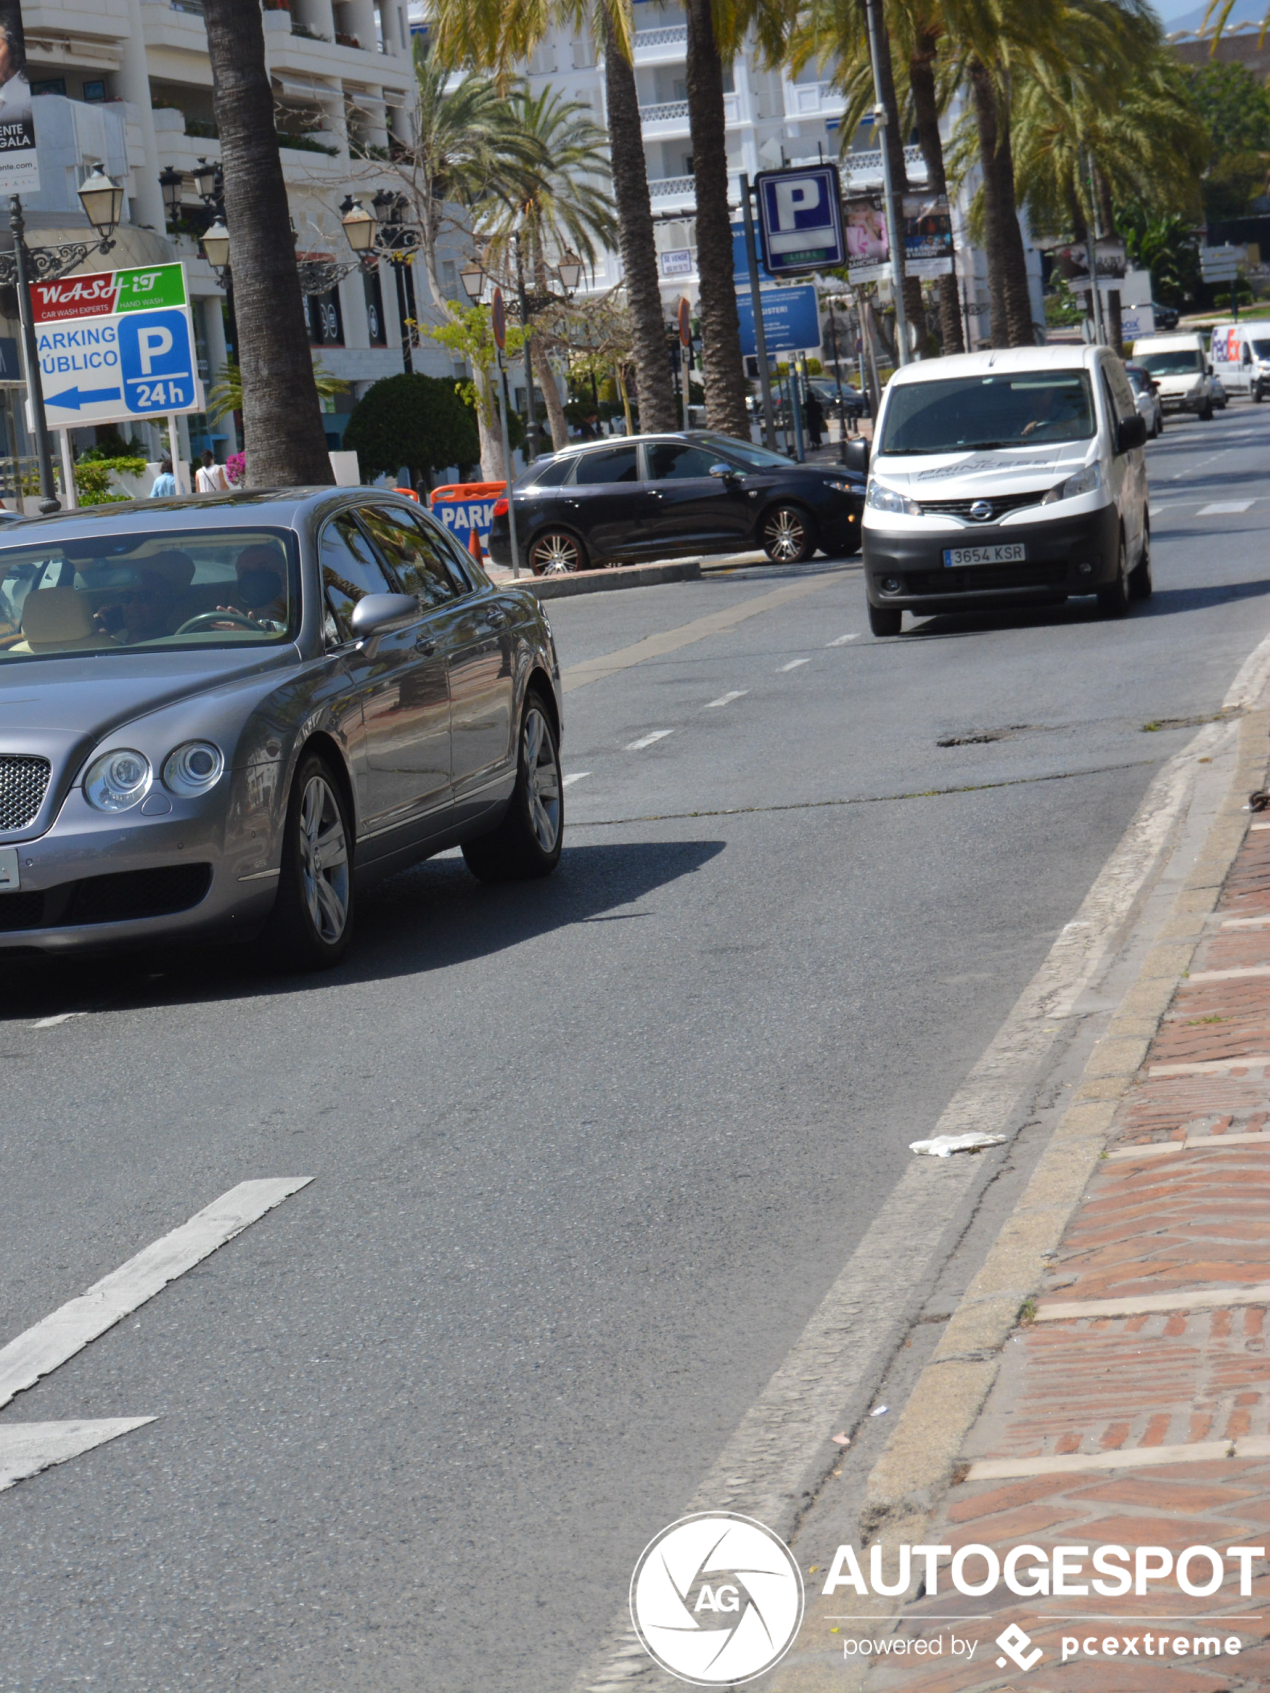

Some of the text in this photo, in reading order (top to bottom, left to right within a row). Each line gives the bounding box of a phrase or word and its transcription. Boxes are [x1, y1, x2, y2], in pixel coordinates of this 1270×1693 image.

[774, 179, 820, 231] P
[42, 304, 109, 319] CAR WASH EXPERTS
[120, 300, 141, 309] HAND
[36, 327, 116, 350] ARKING
[1212, 328, 1241, 362] FedEx
[39, 350, 118, 374] ÚBLICO
[138, 326, 173, 375] P
[918, 460, 1050, 477] PRINCESS
[442, 503, 495, 529] PARK
[954, 546, 1022, 564] 3654 KSR
